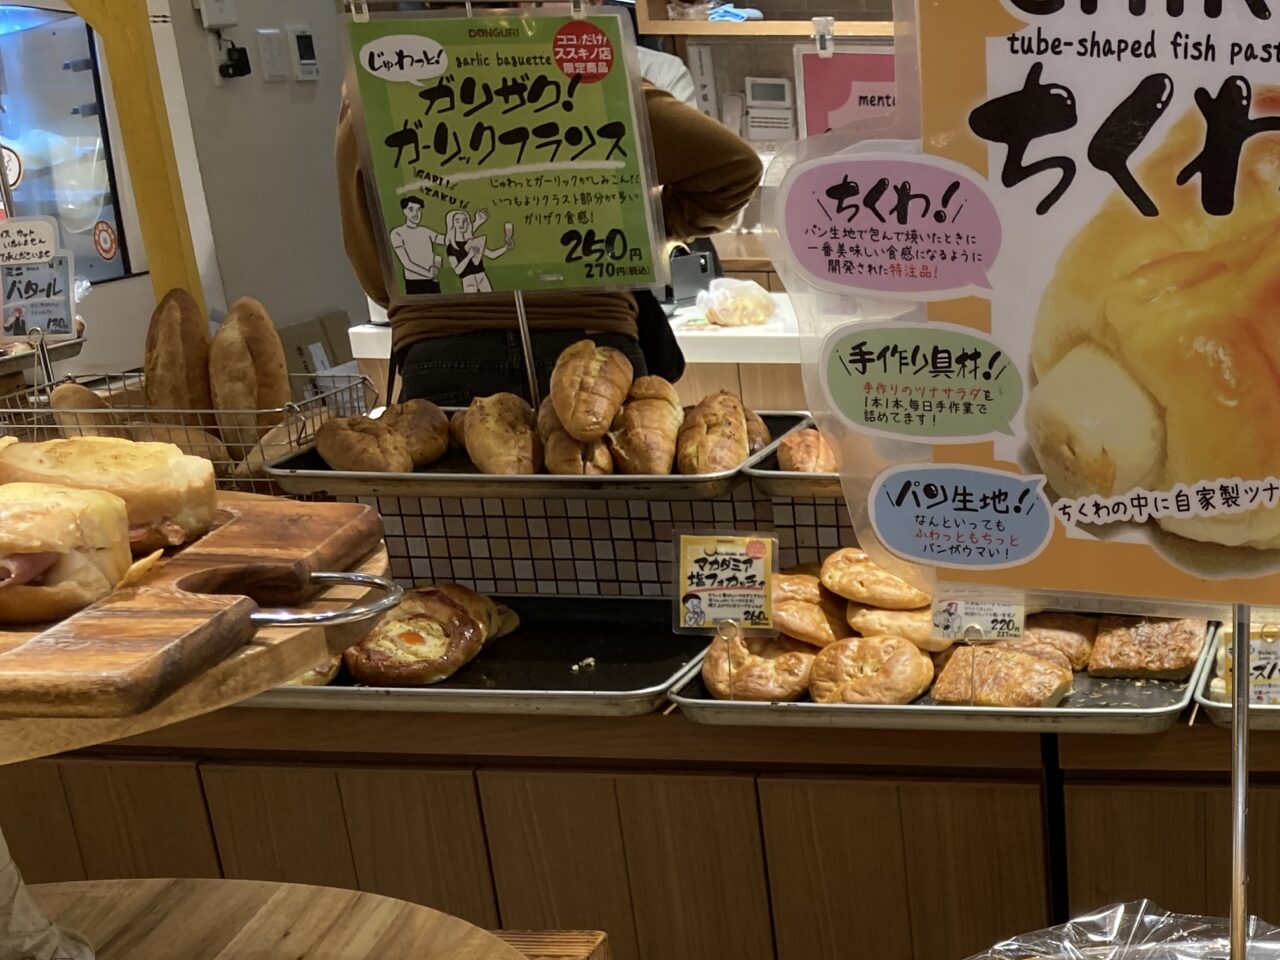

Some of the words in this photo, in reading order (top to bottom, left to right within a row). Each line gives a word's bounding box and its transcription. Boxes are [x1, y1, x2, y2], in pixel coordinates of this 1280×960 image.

[468, 28, 520, 38] DONGURI
[554, 47, 612, 60] ススキノ店
[1006, 27, 1158, 61] tube-shaped
[1171, 31, 1217, 63] fish
[455, 52, 491, 68] garlic
[496, 52, 552, 67] baguette
[563, 61, 609, 74] 限定商品
[384, 119, 628, 168] ガーリックフランス
[825, 174, 961, 225] ちくわ!
[560, 227, 643, 264] 250円
[804, 223, 977, 246] パン生地で包んで焼いたときに
[807, 239, 983, 263] 一番美味しい食感になるように
[6, 278, 63, 300] バタール
[848, 341, 1002, 381] 手作り具材!
[863, 381, 994, 401] 手作りのツナサラダを
[895, 480, 1031, 515] パン生地!
[915, 514, 1006, 532] なんといっても
[915, 529, 1020, 547] ふわっともちっと
[693, 557, 754, 573] マカダミア
